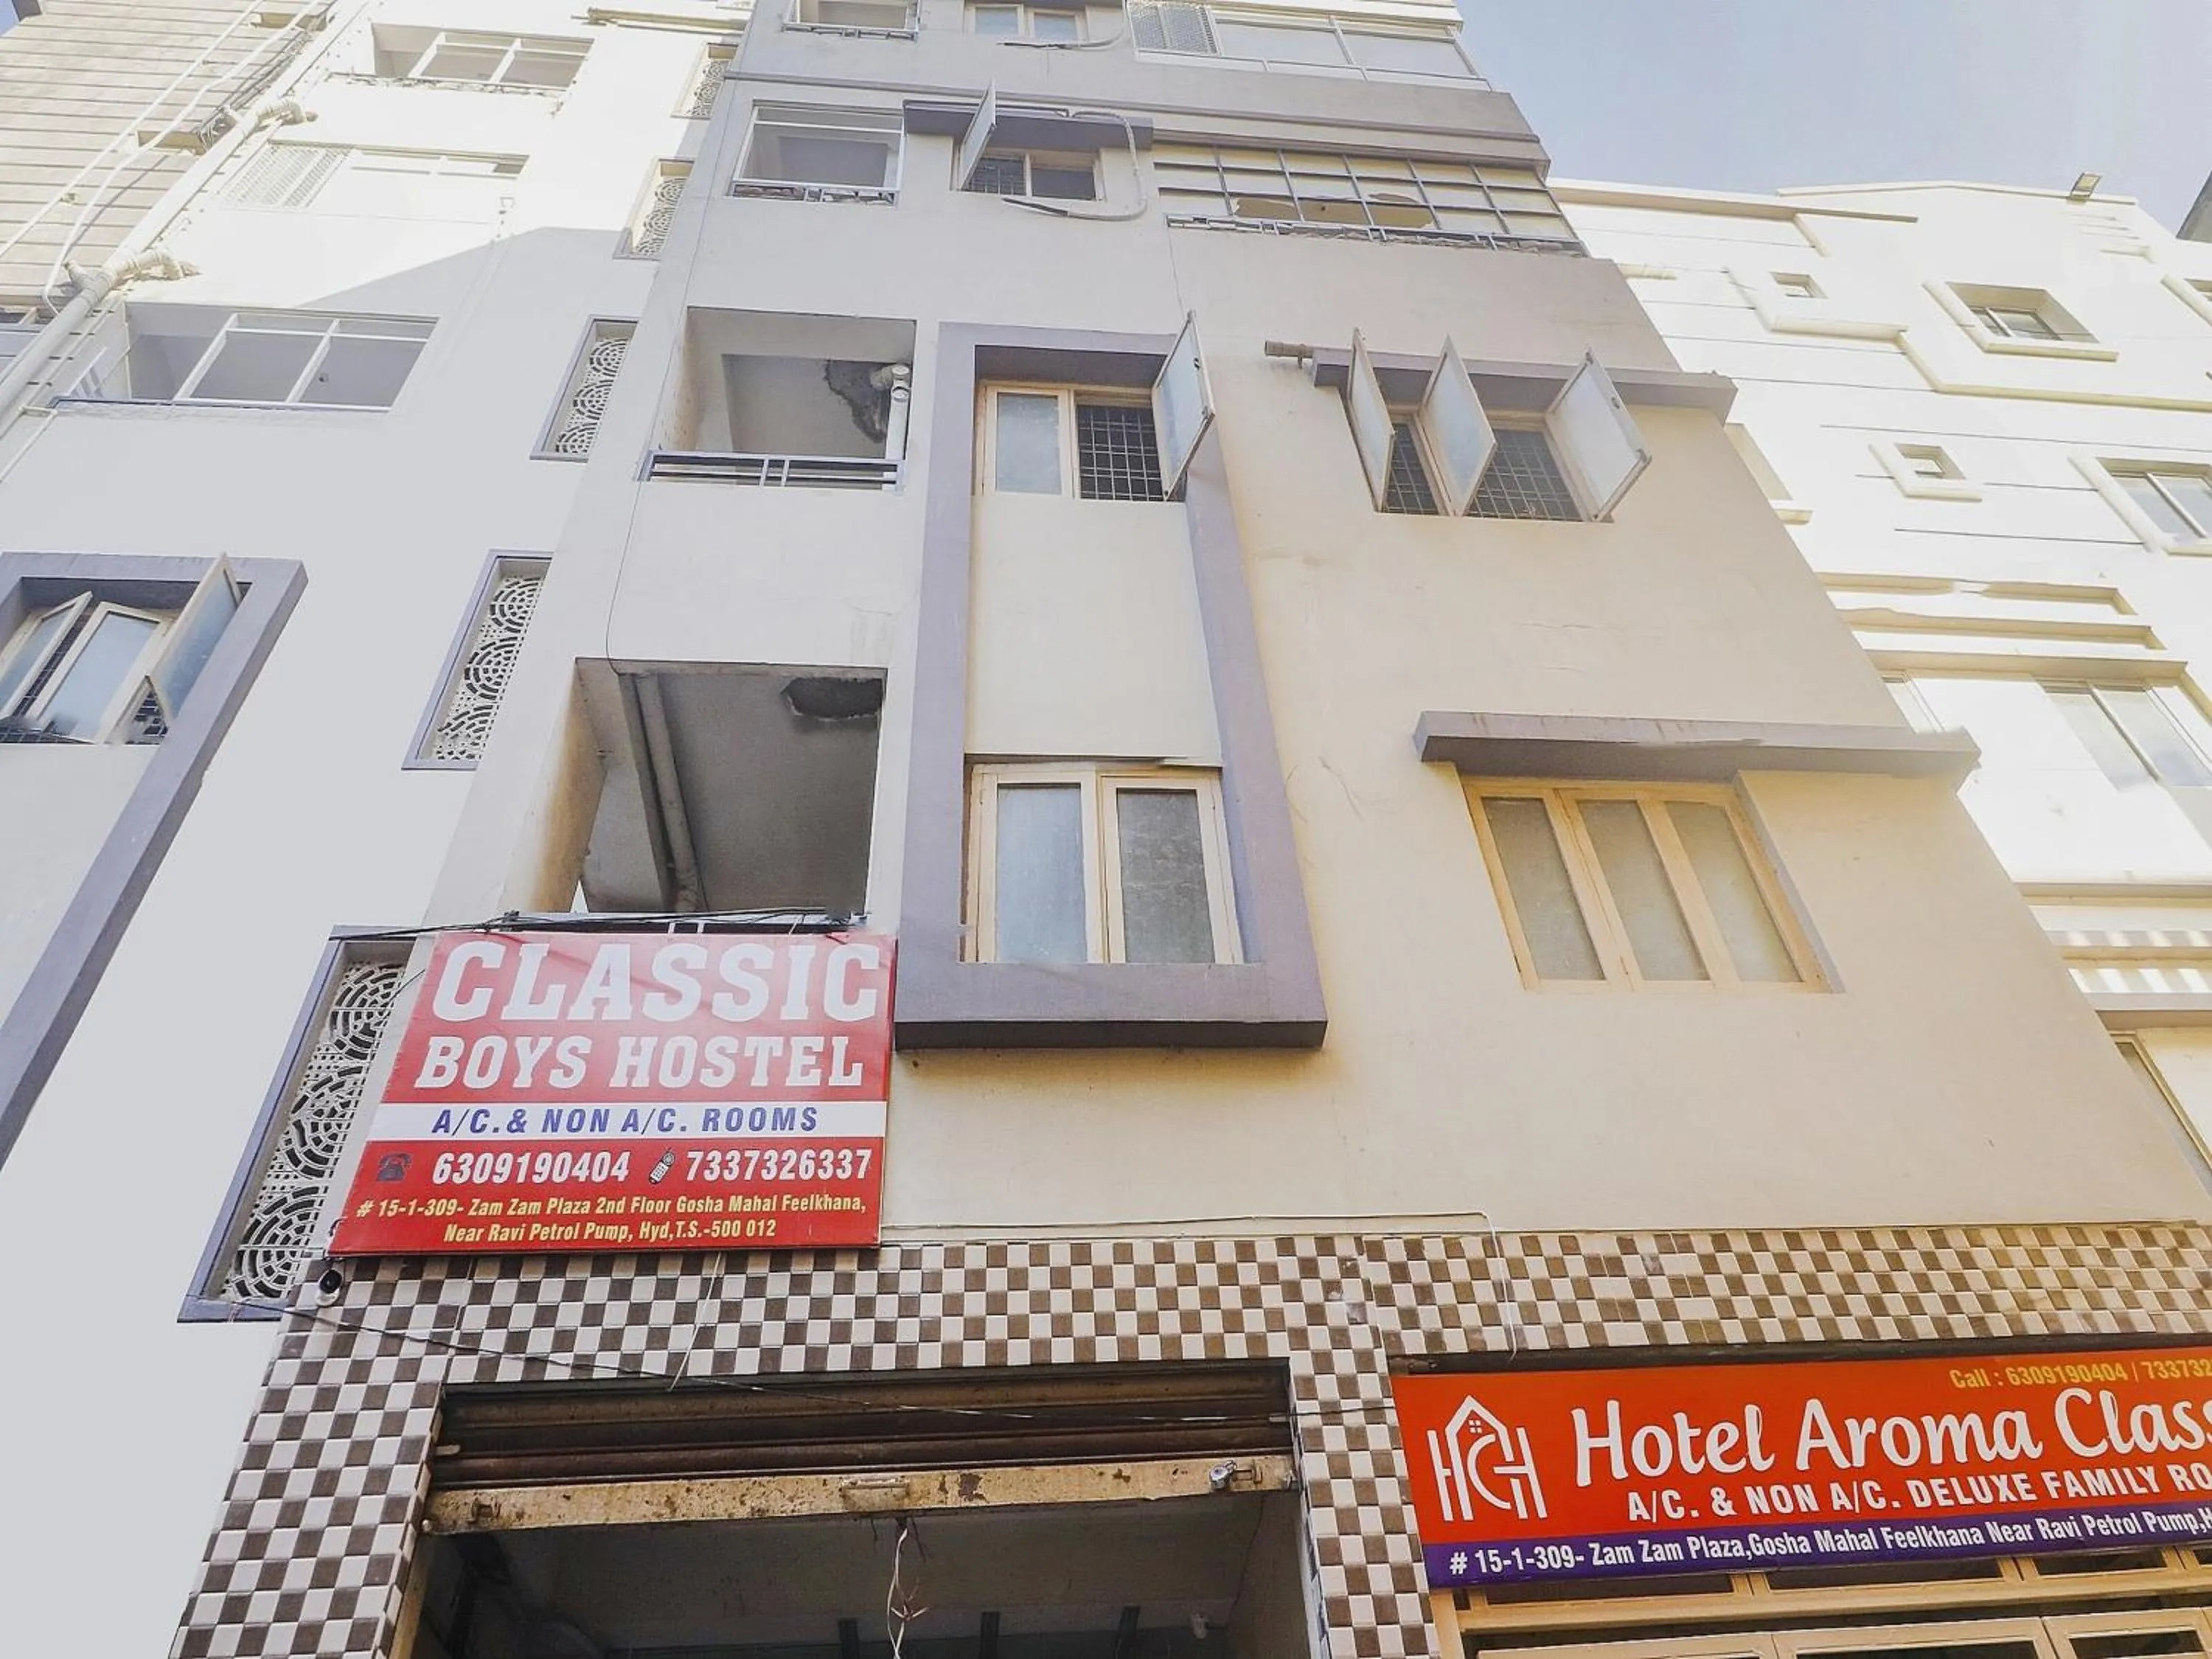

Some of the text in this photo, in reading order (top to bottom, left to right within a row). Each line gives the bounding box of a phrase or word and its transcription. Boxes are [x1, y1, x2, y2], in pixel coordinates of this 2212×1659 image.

[431, 942, 880, 1022] CLASSIC
[414, 1034, 863, 1089] BOYS HOSTEL
[541, 1108, 611, 1134] NON
[621, 1108, 687, 1135] A/C.
[701, 1107, 817, 1132] ROOMS
[432, 1148, 872, 1184] 6309190404 7337326337
[356, 1193, 866, 1217] # 15-1-309- Zam Zam Plaza 2nd Floor Gosha Mahal Feelkhana,
[443, 1220, 777, 1244] Near Ravi Petrol Pump, Hyd,T.S.-500 012
[1950, 1368, 1992, 1389] Call
[2006, 1363, 2128, 1386] 6309190404
[1571, 1387, 2212, 1487] Hotel Aroma Clas
[1628, 1489, 1699, 1523] A/C.
[1710, 1485, 1737, 1517] &
[1743, 1484, 1819, 1515] NON
[1829, 1480, 1901, 1514] A/C.
[1905, 1473, 2037, 1509] DELUXE
[2040, 1464, 2160, 1500] FAMILY
[1450, 1551, 1468, 1575] #
[1475, 1545, 1585, 1573] 15-1-309-
[1588, 1542, 1635, 1566] Zam
[1638, 1538, 1684, 1563] Zam
[1686, 1530, 1812, 1561] Plaza,Gosha
[1813, 1526, 1879, 1551] Mahal
[1880, 1524, 1985, 1549] Feelkhana
[1984, 1519, 2034, 1543] Near
[2034, 1514, 2083, 1541] Ravi
[2083, 1513, 2142, 1537] Petrol
